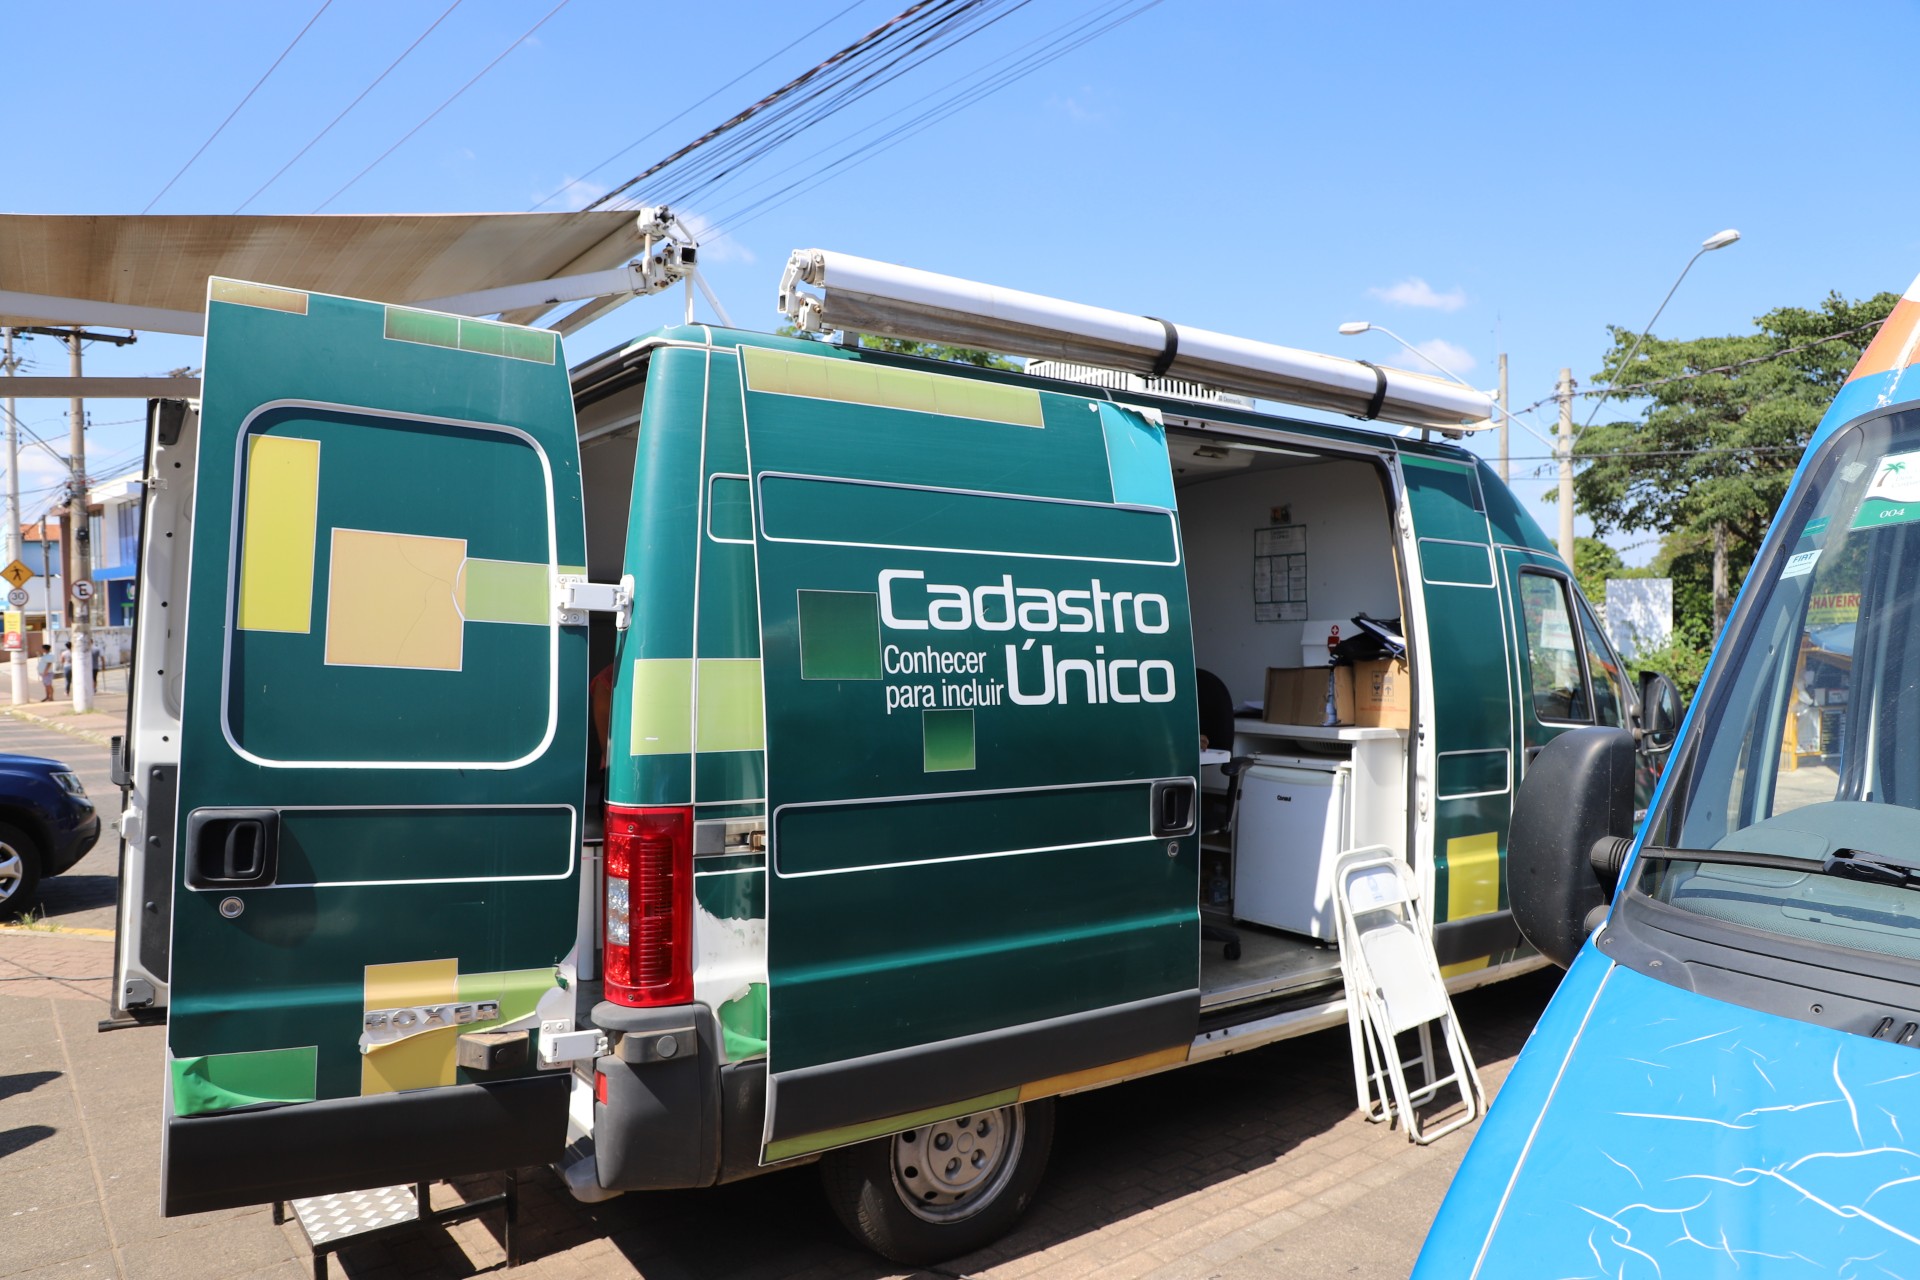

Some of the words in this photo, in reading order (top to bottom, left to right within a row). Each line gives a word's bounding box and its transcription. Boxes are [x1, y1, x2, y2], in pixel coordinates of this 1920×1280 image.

[1880, 508, 1905, 518] 004
[1793, 552, 1815, 563] FIAT
[12, 592, 25, 600] 30
[878, 568, 1170, 634] Cadastro
[1809, 594, 1862, 609] HAVEIRO
[883, 644, 987, 675] Conhecer
[1005, 638, 1176, 705] Único
[885, 684, 936, 715] para
[942, 678, 1004, 707] incluir
